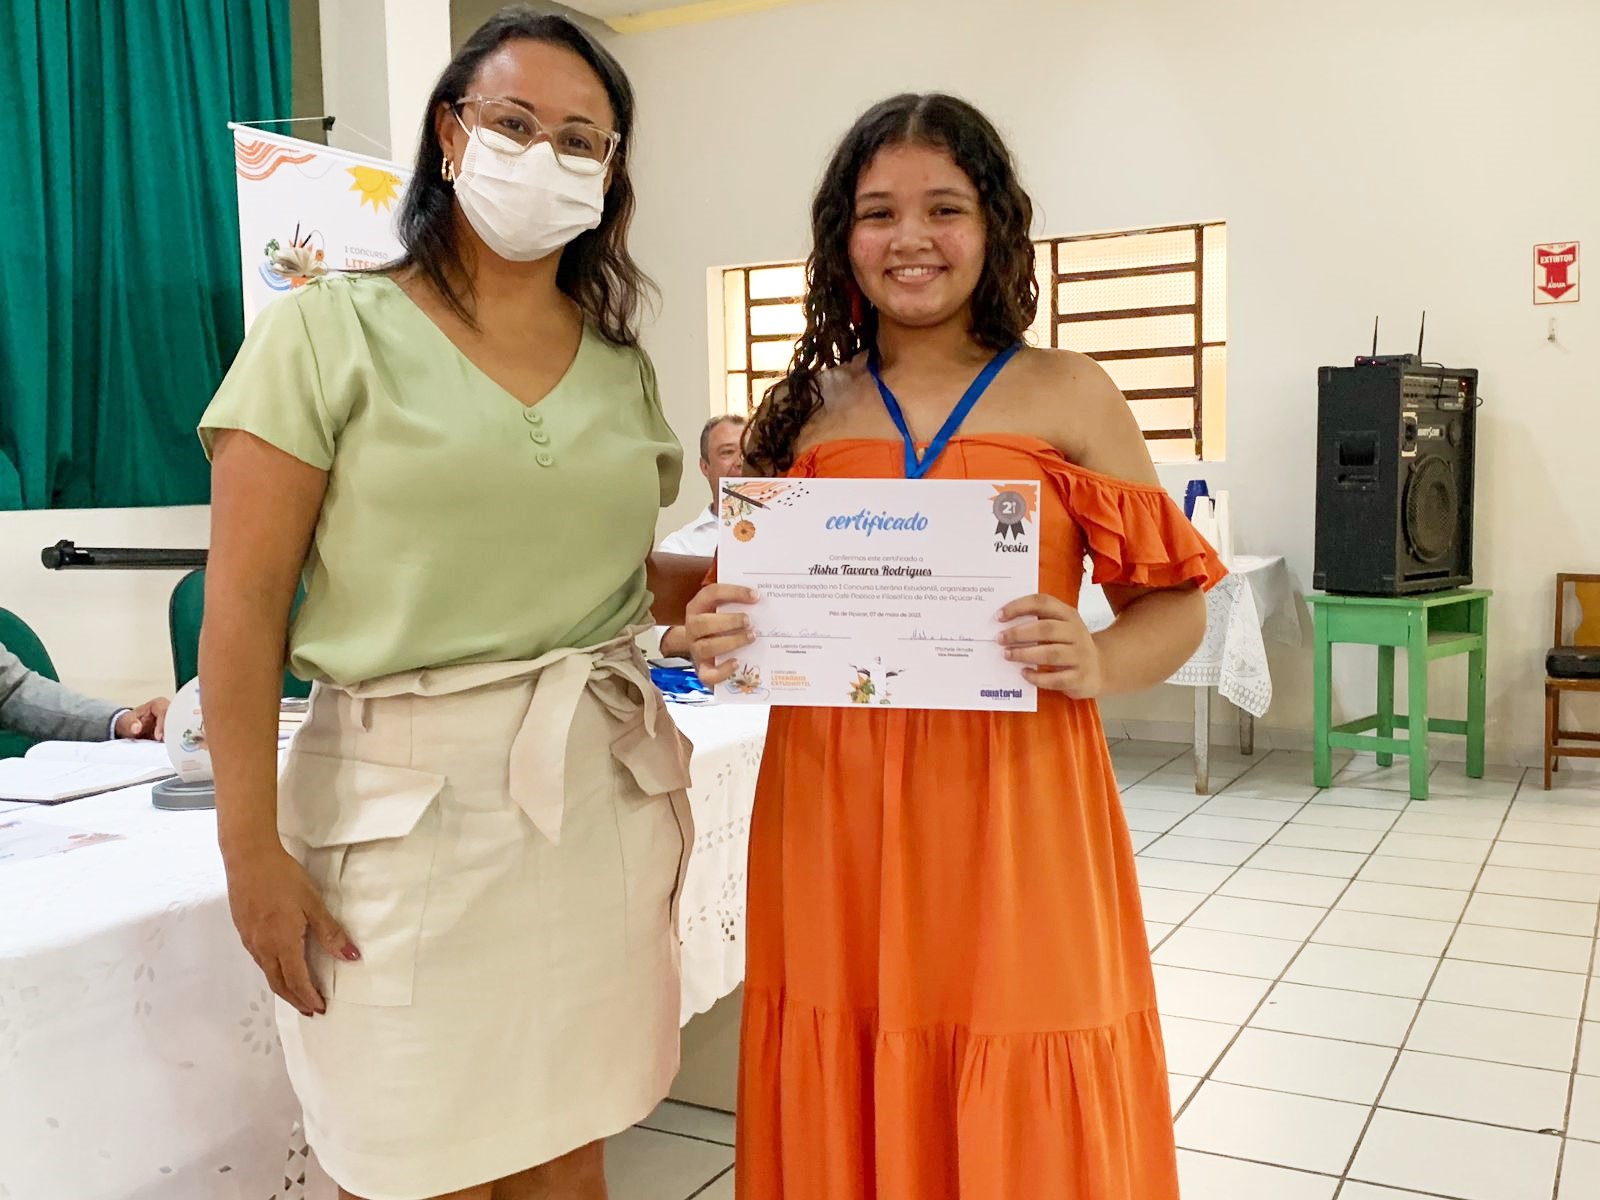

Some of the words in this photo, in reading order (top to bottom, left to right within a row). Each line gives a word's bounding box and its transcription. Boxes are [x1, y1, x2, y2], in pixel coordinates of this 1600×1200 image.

[350, 246, 389, 260] CONCURSO
[1540, 254, 1574, 264] EXTINTOR
[825, 508, 929, 537] certificado
[994, 541, 1029, 553] Poesia
[882, 555, 918, 563] certificado
[808, 563, 838, 576] Aisha
[840, 564, 879, 576] Tavares
[882, 564, 932, 579] Rodrigues
[843, 583, 874, 591] Concurso
[980, 688, 1023, 698] equatorial
